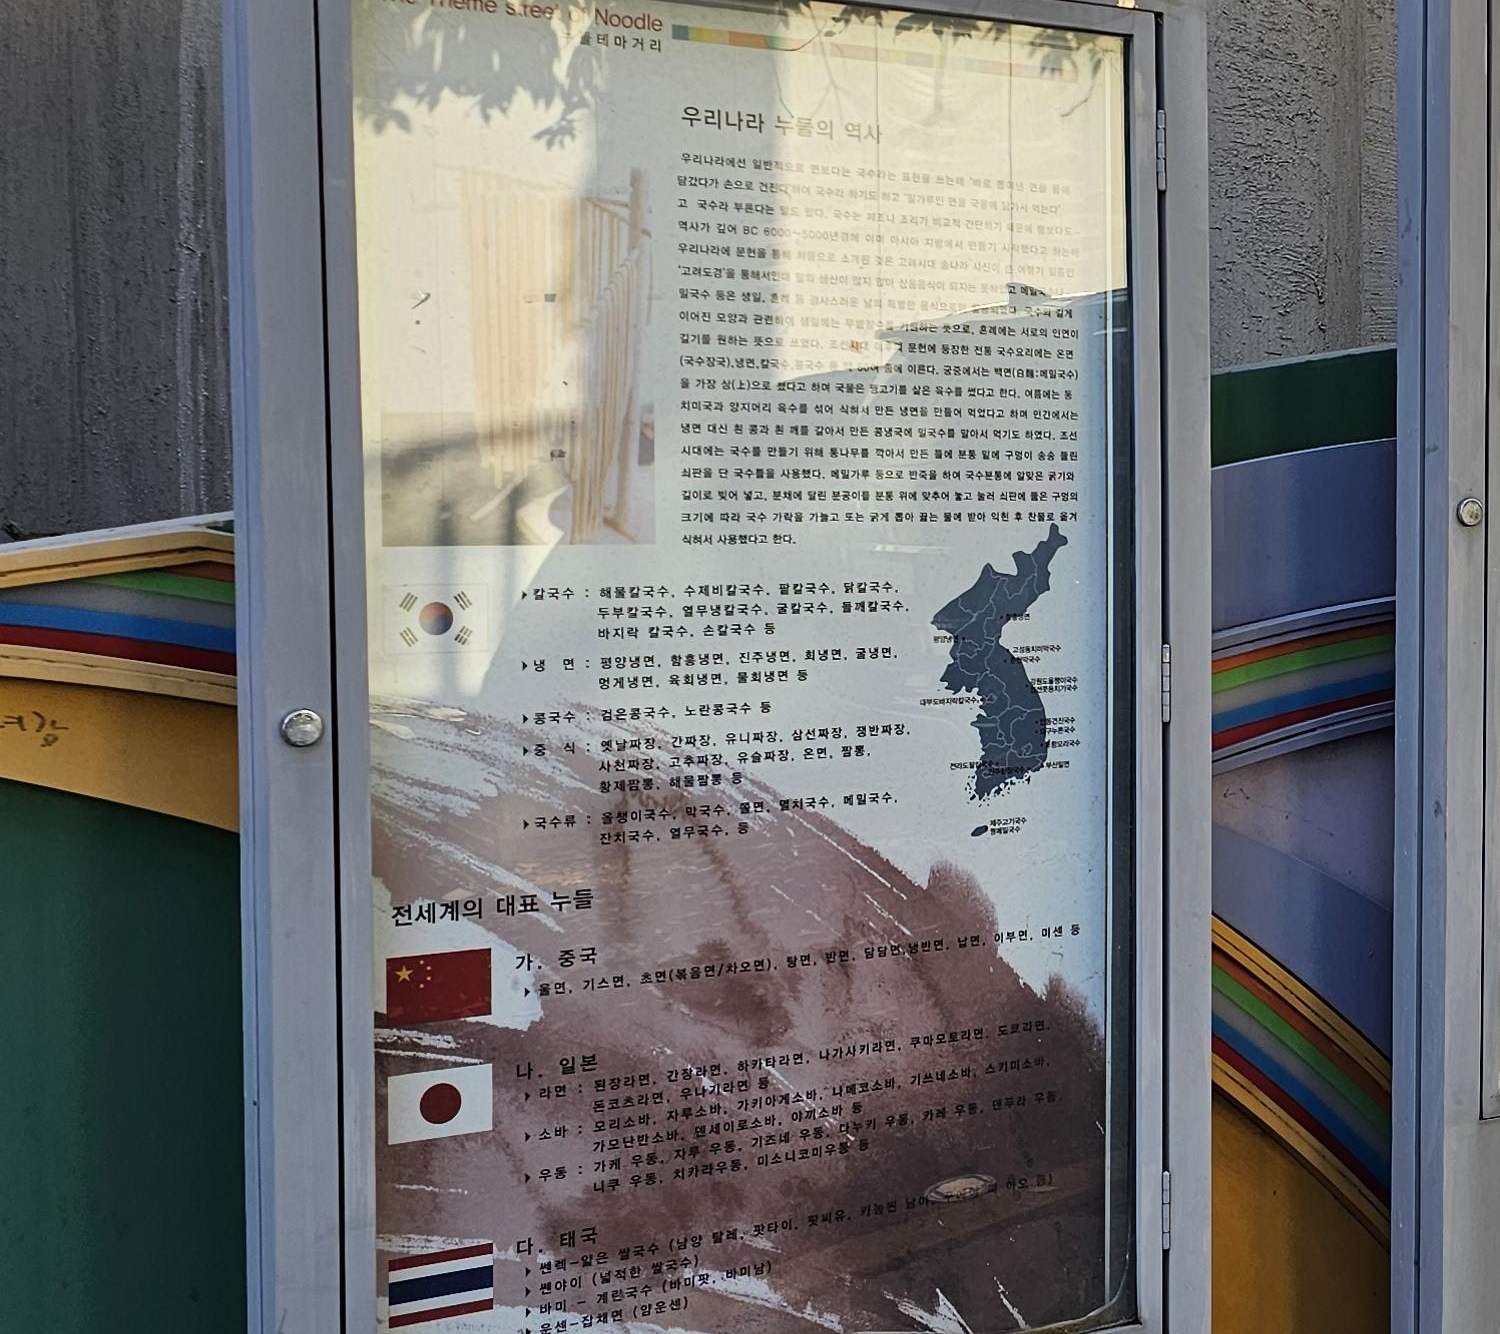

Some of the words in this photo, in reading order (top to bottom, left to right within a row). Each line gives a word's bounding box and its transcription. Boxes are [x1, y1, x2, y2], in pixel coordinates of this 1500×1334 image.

[594, 7, 664, 32] Noodle
[681, 106, 765, 134] 우리나라
[680, 400, 723, 412] 치미국과
[729, 401, 771, 413] 양지머리
[777, 402, 807, 414] 육수를
[839, 404, 869, 416] 식혀서
[874, 405, 894, 416] 만든
[899, 406, 928, 417] 냉면을
[933, 406, 961, 418] 만들어
[967, 407, 1005, 419] 먹었다고
[1009, 408, 1027, 419] 하며
[1032, 409, 1078, 421] 민간에서는
[681, 534, 712, 545] 식혀서
[716, 533, 768, 545] 사용했다고
[533, 587, 574, 601] 칼국수
[597, 626, 639, 640] 바지락
[702, 623, 755, 637] 손칼국수
[763, 622, 775, 635] 등
[737, 669, 788, 684] 물회냉면
[796, 669, 808, 682] 등
[533, 710, 575, 725] 콩국수
[684, 702, 751, 717] 노란콩국수
[759, 701, 771, 714] 등
[731, 771, 742, 785] 등
[534, 814, 576, 830] 국수류
[737, 821, 748, 835] 등
[391, 897, 482, 927] 전세계의
[496, 894, 539, 916] 대표
[550, 888, 593, 912] 누들
[558, 946, 597, 968] 중국
[559, 1053, 598, 1075] 일본
[559, 1226, 597, 1248] 태국
